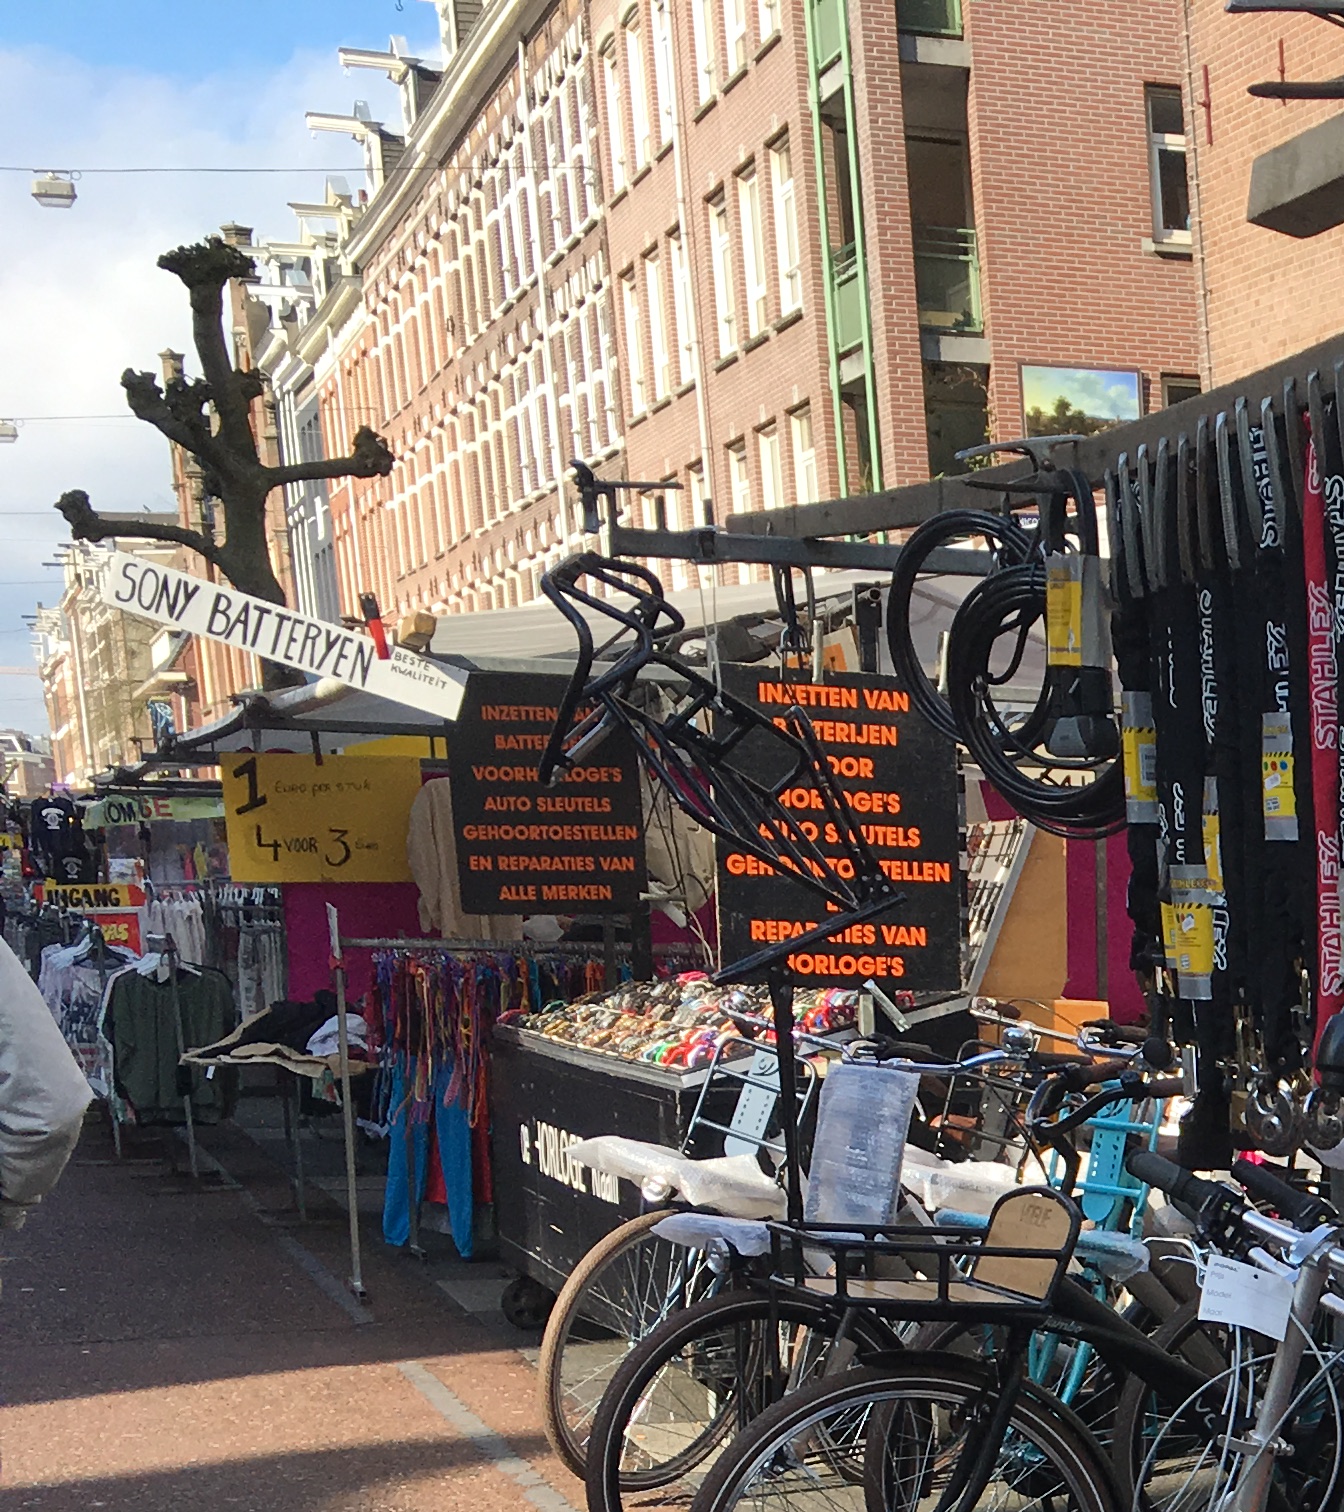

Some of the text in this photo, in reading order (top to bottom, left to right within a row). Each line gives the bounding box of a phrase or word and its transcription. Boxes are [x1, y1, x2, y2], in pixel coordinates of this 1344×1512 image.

[115, 562, 375, 688] SONY BATTERYEN
[393, 651, 432, 672] BESTE
[1309, 580, 1340, 751] STAHLEX
[863, 688, 909, 712] VAN
[481, 705, 558, 721] INZETTEN
[772, 717, 898, 746] BTERIJEN
[815, 756, 874, 779] OOR
[484, 796, 612, 813] AUTO SLEUTELS
[778, 788, 901, 814] HORGE'S
[462, 824, 638, 841] GEHOORTOESTELLEN
[825, 822, 921, 848] SUTELS
[256, 824, 281, 862] 4
[283, 837, 318, 854] VOOR
[325, 827, 351, 868] 3
[469, 856, 635, 872] EN REPARATIES VAN
[499, 885, 613, 901] ALLE MERKEN
[1317, 830, 1344, 997] STAHLEX
[751, 920, 927, 946] REPATIES VAN
